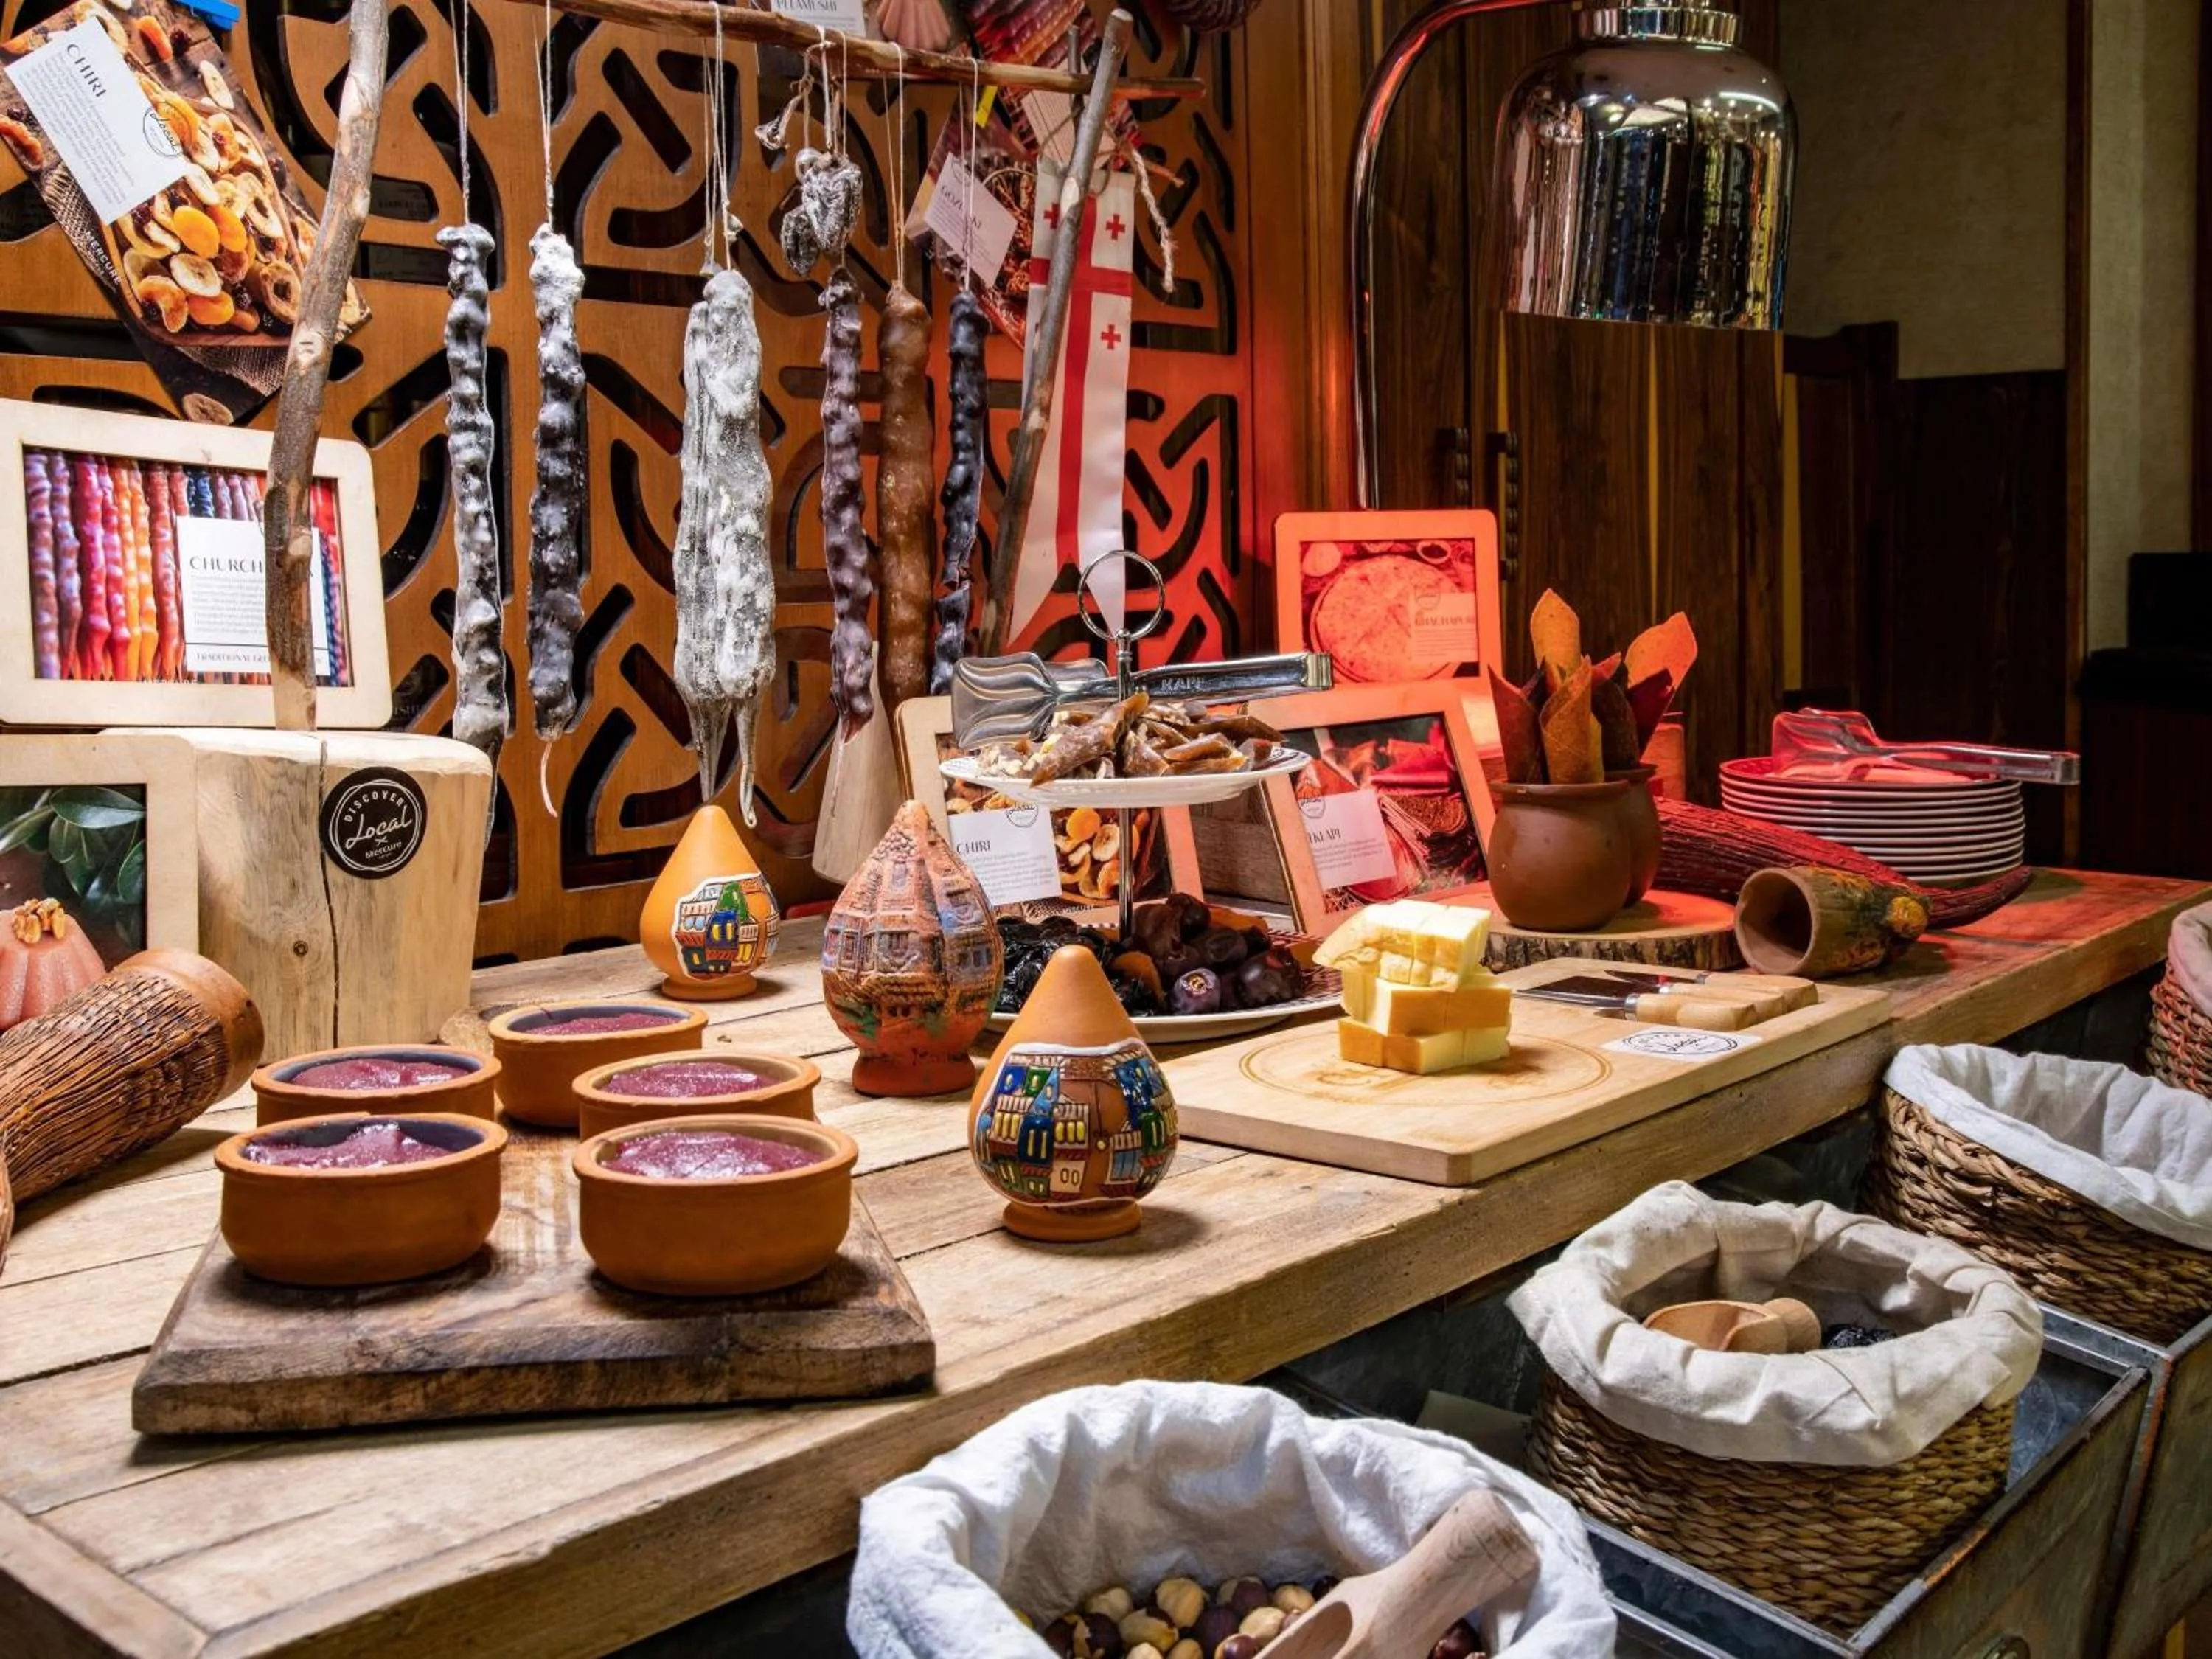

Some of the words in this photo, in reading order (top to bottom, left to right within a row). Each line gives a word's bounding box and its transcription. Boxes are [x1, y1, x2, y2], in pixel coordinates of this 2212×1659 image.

[67, 44, 106, 97] CHIRI
[344, 790, 405, 823] DISCOVER
[345, 804, 413, 849] Local
[956, 839, 990, 855] CHIRI
